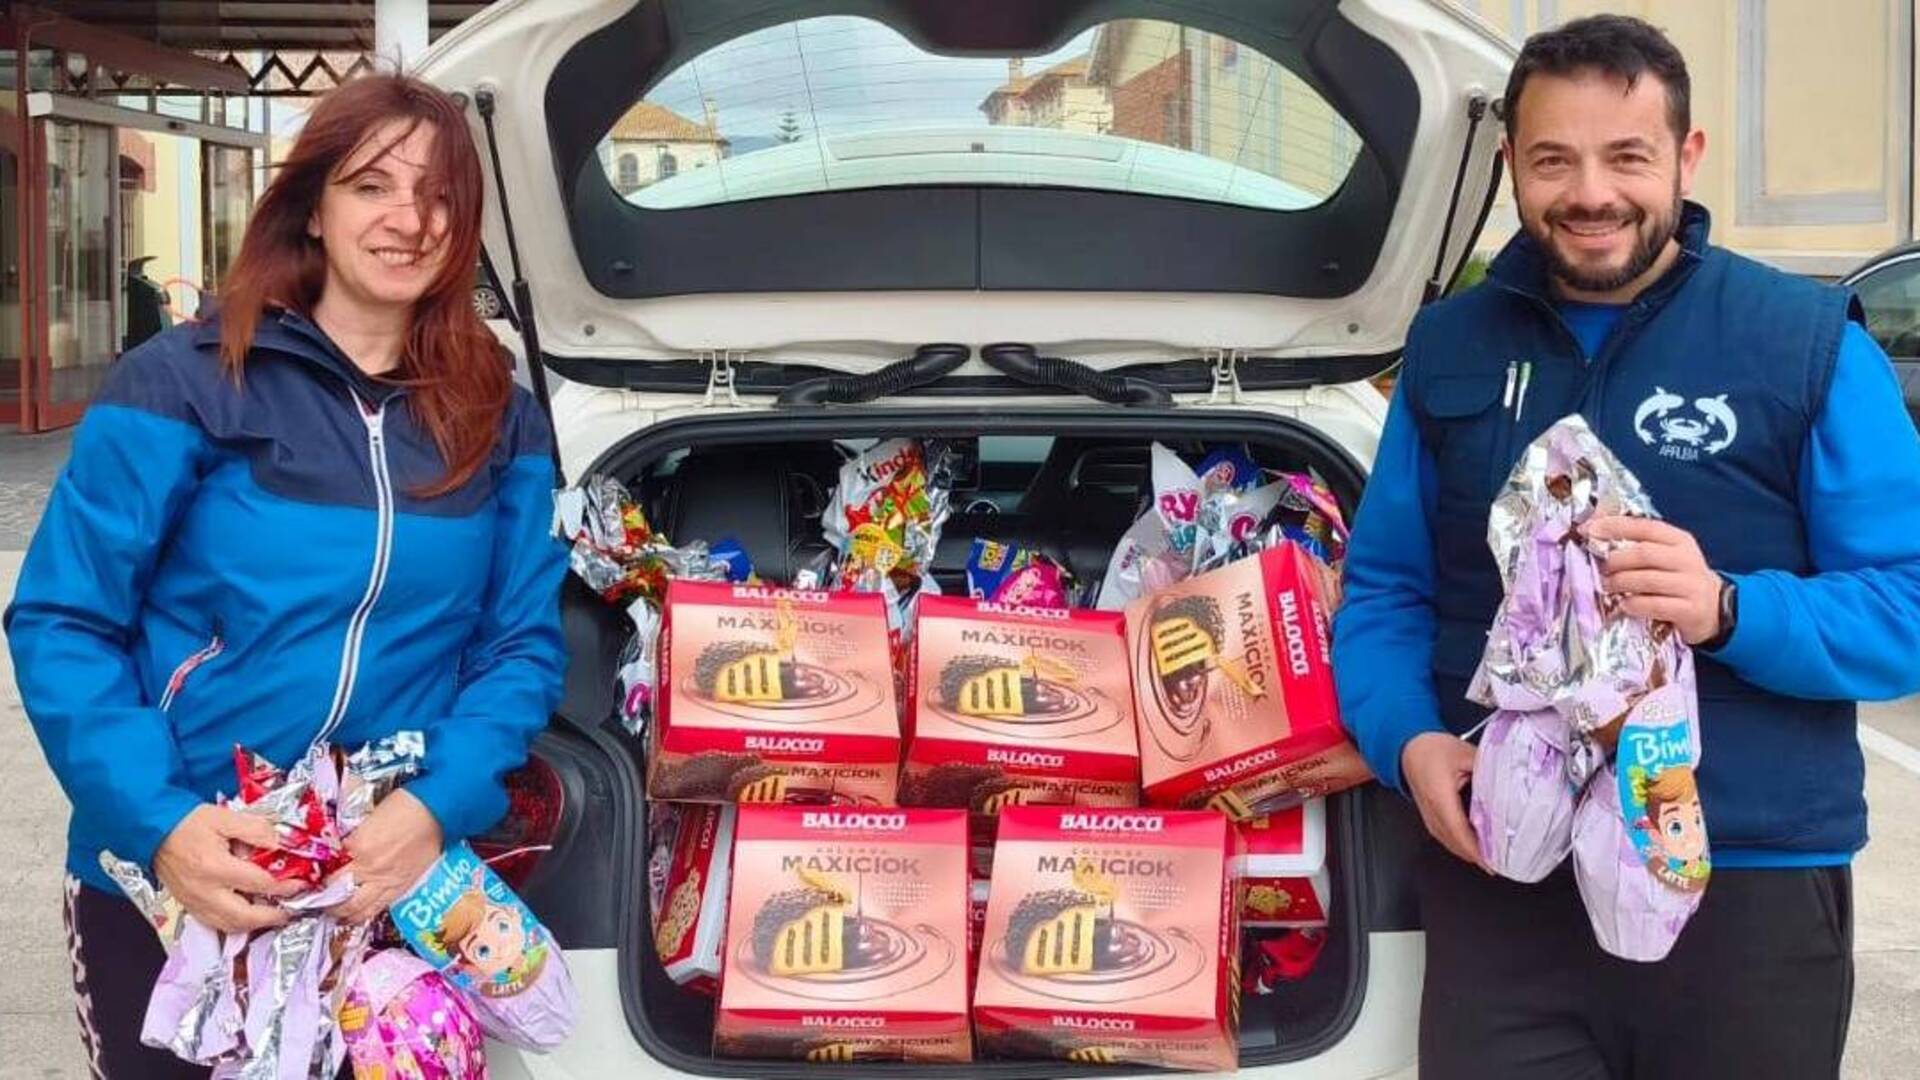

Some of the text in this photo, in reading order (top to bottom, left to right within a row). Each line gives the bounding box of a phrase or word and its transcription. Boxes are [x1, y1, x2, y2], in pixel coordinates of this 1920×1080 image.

[732, 586, 829, 602] BALOCCO
[977, 601, 1071, 619] BALOCCO
[717, 615, 846, 636] MAXIIOK
[1278, 590, 1311, 677] BALOCCO
[961, 630, 1087, 652] MAXICIOK
[745, 736, 824, 751] BALOCCO
[987, 749, 1065, 767] BALOCCO
[1203, 748, 1278, 782] BALOCCO
[791, 767, 882, 780] MAXICIOK
[1031, 781, 1123, 796] MAXICIOK
[802, 812, 907, 830] BALOCCO
[1059, 814, 1163, 832] BALOCCO
[781, 854, 921, 875] MAXICIOK
[399, 857, 472, 929] Bimbo
[801, 1015, 886, 1028] BALOCCO
[1053, 1015, 1136, 1030] BALOCCO
